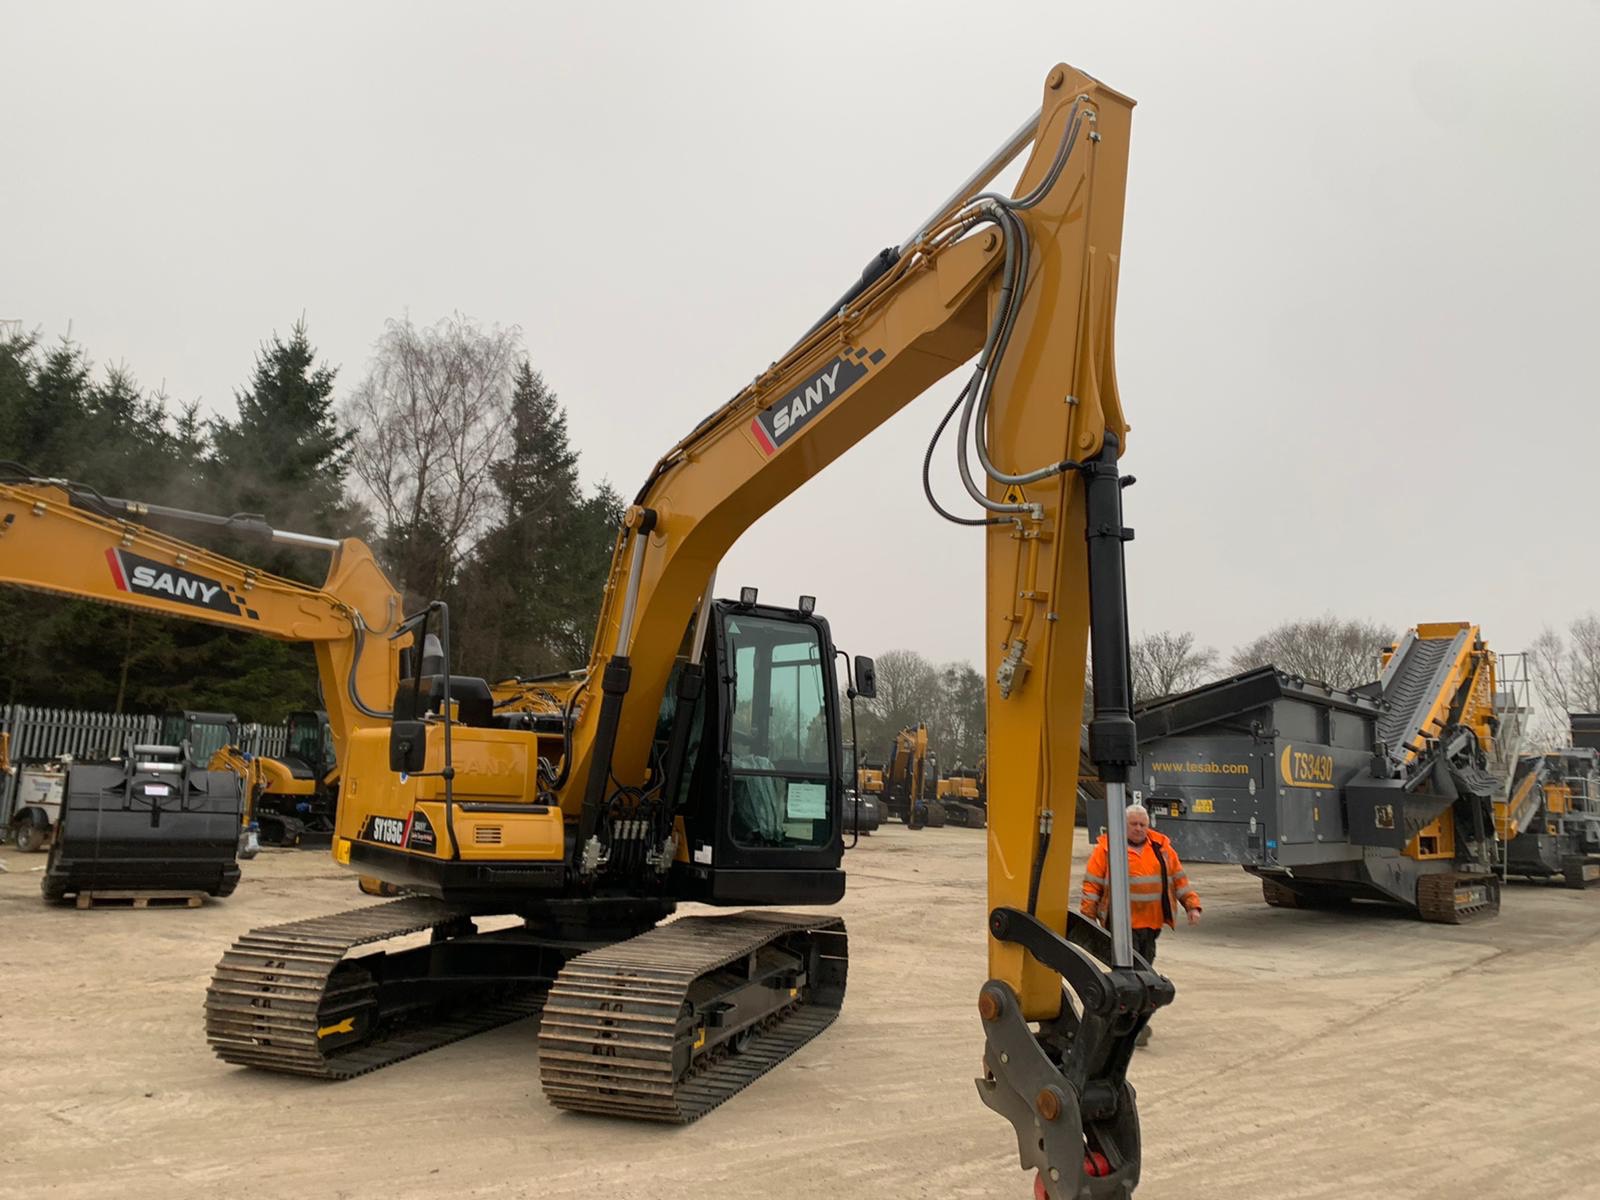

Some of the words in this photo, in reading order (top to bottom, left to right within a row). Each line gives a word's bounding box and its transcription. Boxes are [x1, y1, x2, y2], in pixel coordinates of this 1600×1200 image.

[773, 362, 840, 438] SANY
[132, 566, 220, 603] SANY
[1152, 761, 1249, 774] www.tesab.com
[1294, 752, 1333, 781] TS3430
[373, 817, 403, 844] SY135C
